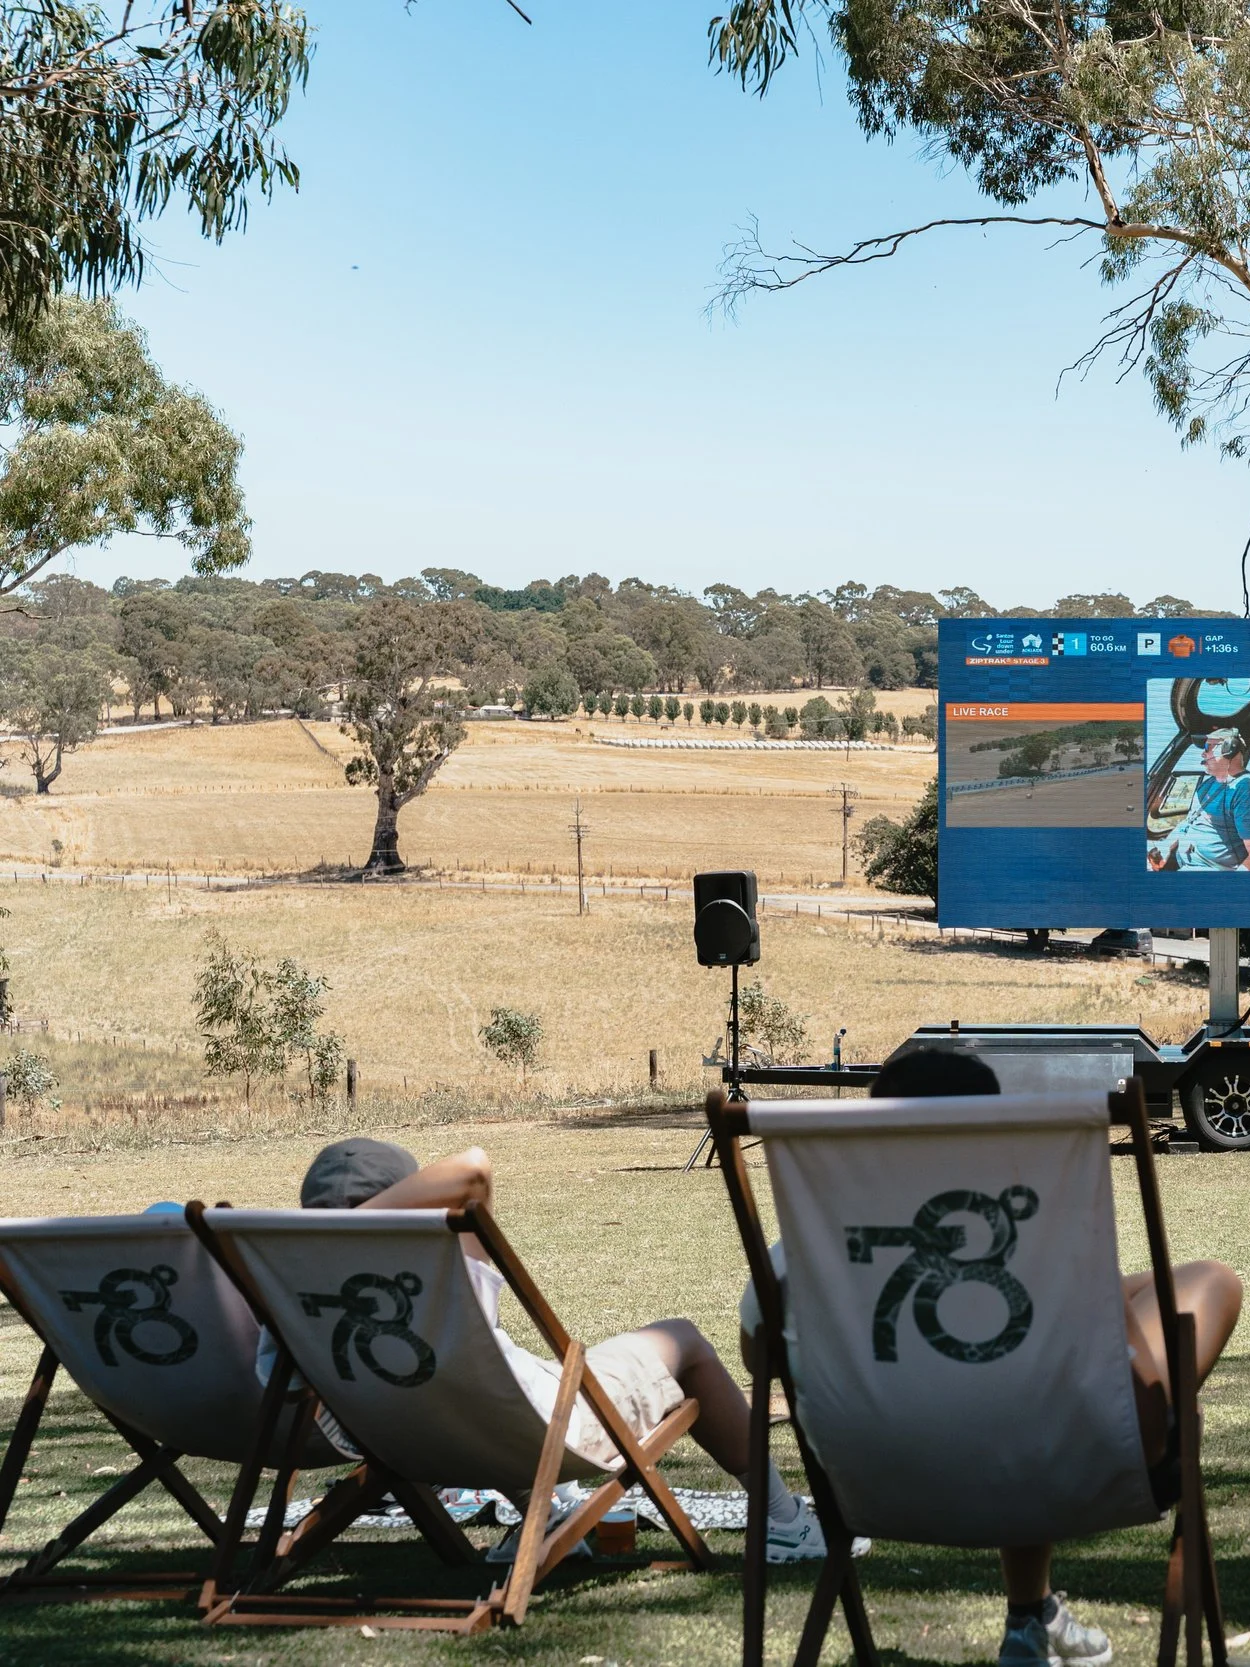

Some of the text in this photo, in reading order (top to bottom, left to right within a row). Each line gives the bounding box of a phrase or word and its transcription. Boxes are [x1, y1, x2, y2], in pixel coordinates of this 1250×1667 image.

[1071, 638, 1079, 650] 1
[1090, 643, 1114, 652] 60.6
[1144, 638, 1154, 648] P
[1205, 643, 1232, 653] +1:36
[1013, 657, 1039, 665] STAGE
[1040, 657, 1046, 665] 3
[953, 707, 1009, 716] LIVE RACE
